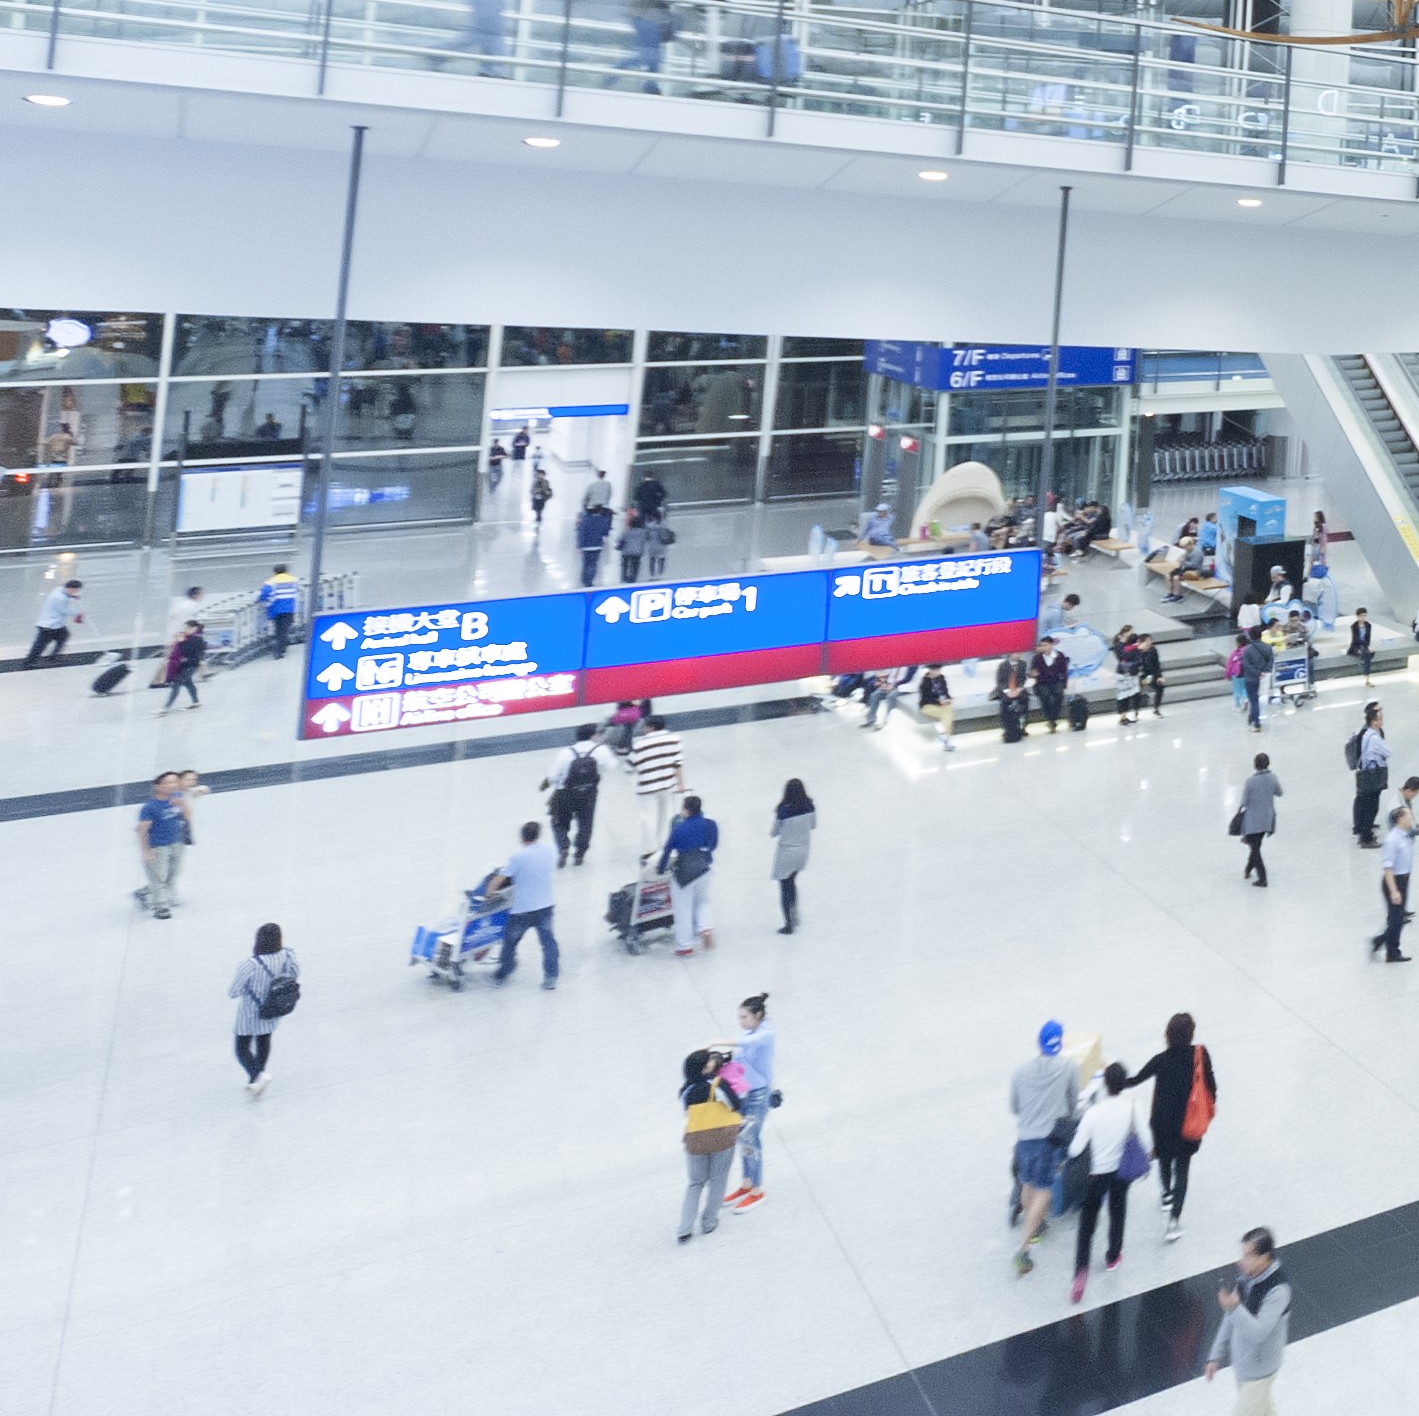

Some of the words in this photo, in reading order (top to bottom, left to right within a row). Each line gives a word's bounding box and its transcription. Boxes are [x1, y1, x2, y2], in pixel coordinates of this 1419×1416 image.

[952, 350, 986, 366] 7/F
[950, 371, 985, 388] 6/F
[742, 586, 758, 612] 1
[461, 612, 488, 640] B
